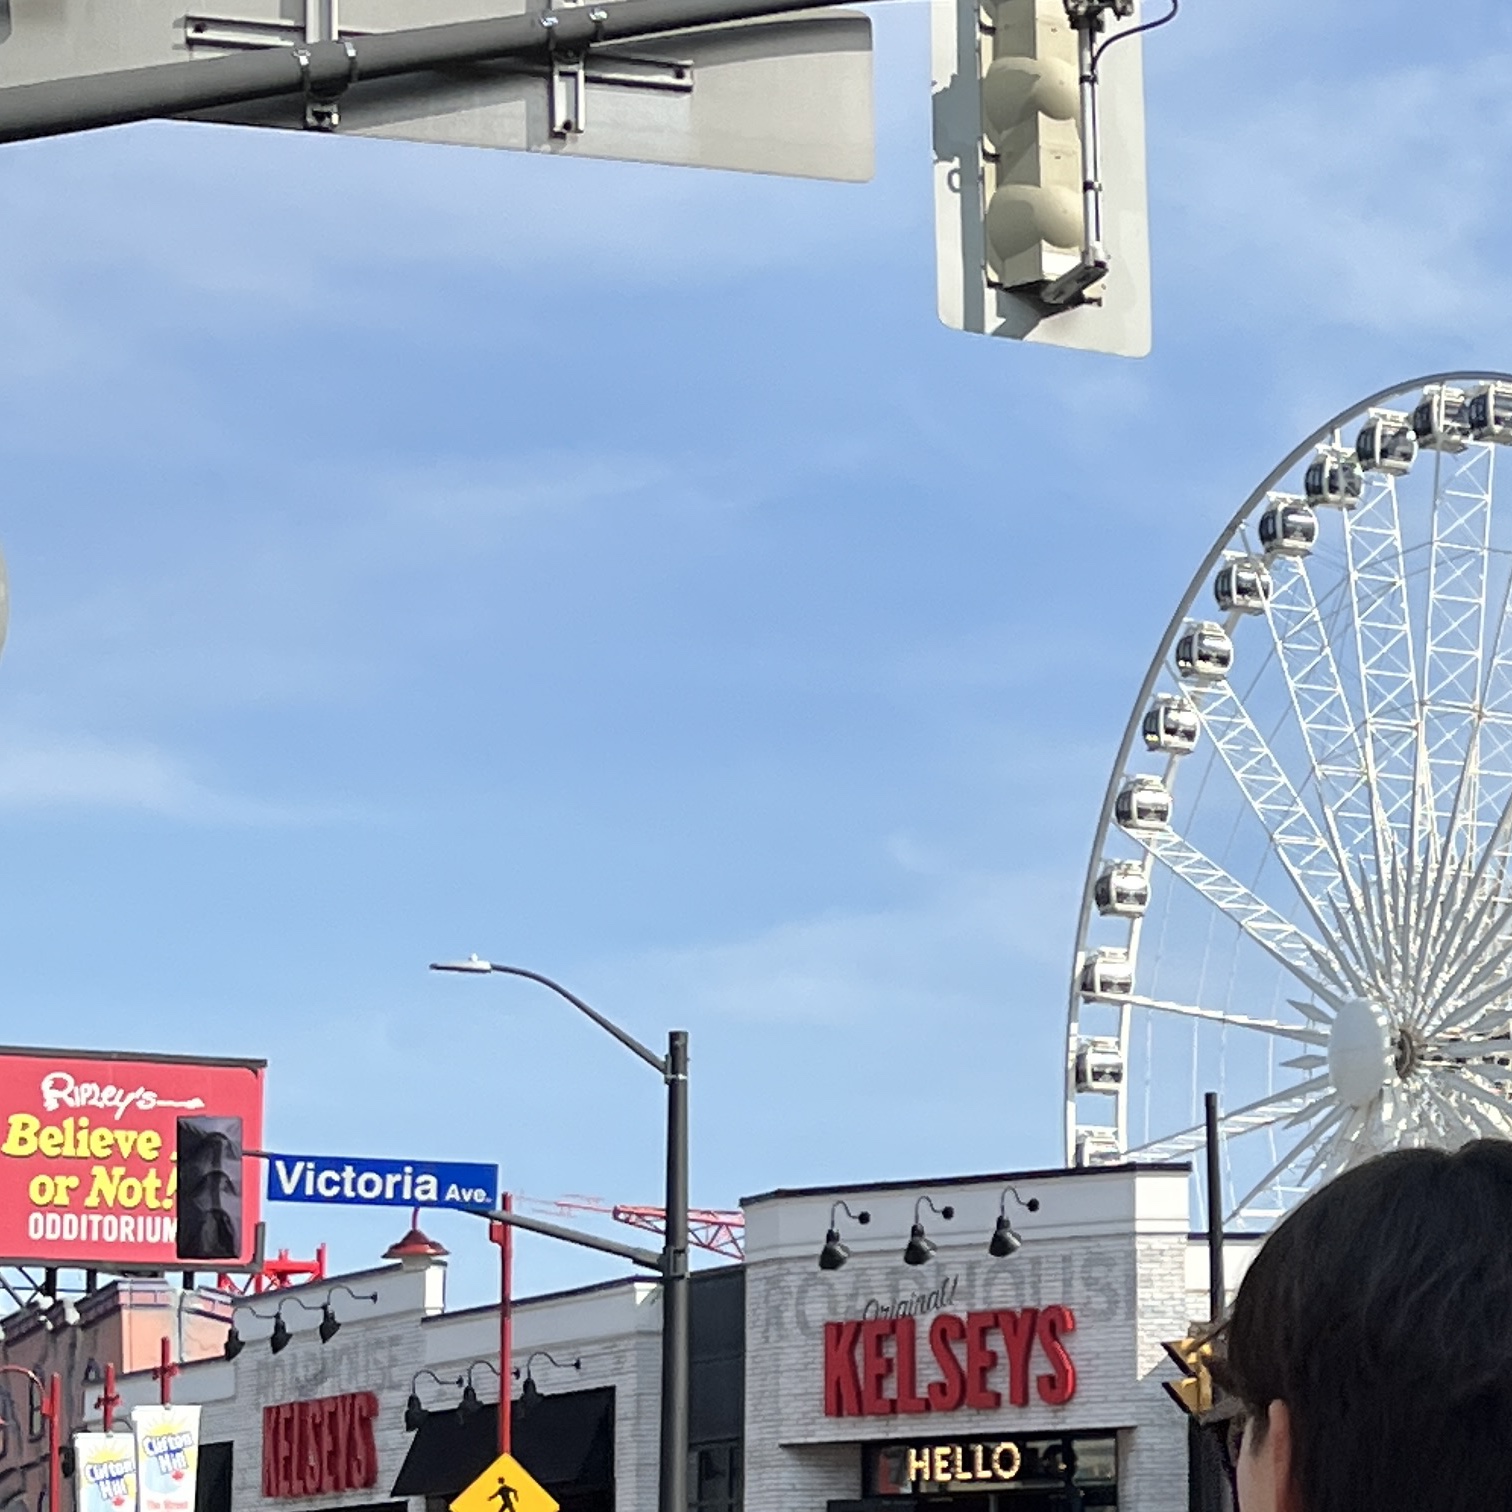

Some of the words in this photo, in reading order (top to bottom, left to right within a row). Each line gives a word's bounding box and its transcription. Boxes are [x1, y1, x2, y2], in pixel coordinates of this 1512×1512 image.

[1, 1113, 163, 1161] Believe
[28, 1174, 80, 1207] or
[275, 1160, 438, 1201] Victoria
[444, 1183, 492, 1203] Ave.
[824, 1305, 1077, 1418] KELSEYS
[142, 1431, 194, 1456] Clifton
[159, 1451, 189, 1475] Hill
[262, 1391, 379, 1498] KELSEYS
[907, 1441, 1021, 1483] HELLO
[84, 1459, 136, 1483] Clifton
